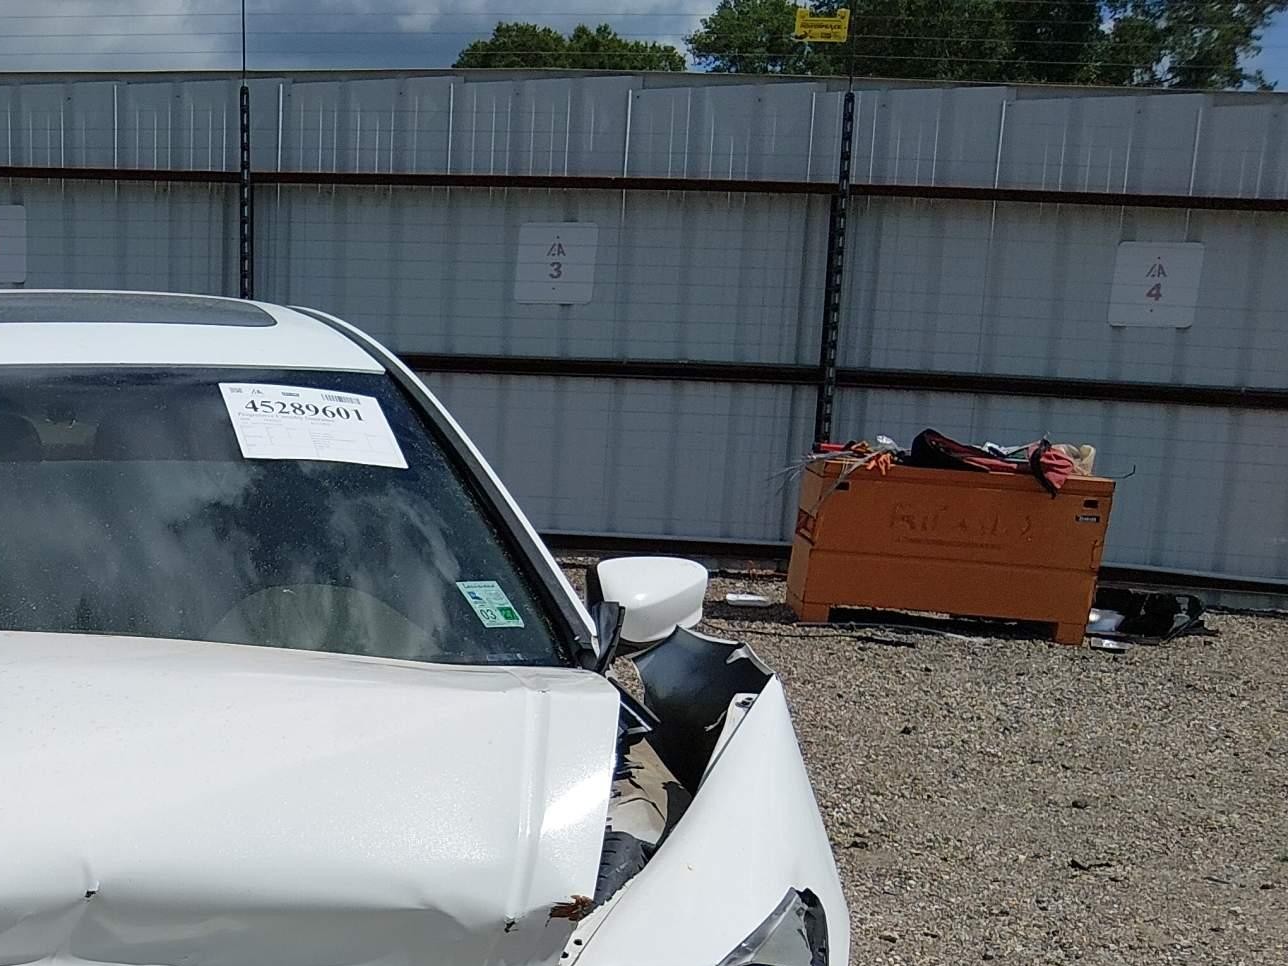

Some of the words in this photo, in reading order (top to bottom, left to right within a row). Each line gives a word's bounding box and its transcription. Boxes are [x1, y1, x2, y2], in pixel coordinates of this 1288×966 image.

[549, 262, 562, 278] 3
[1146, 283, 1162, 301] 4
[245, 399, 365, 422] 45289601
